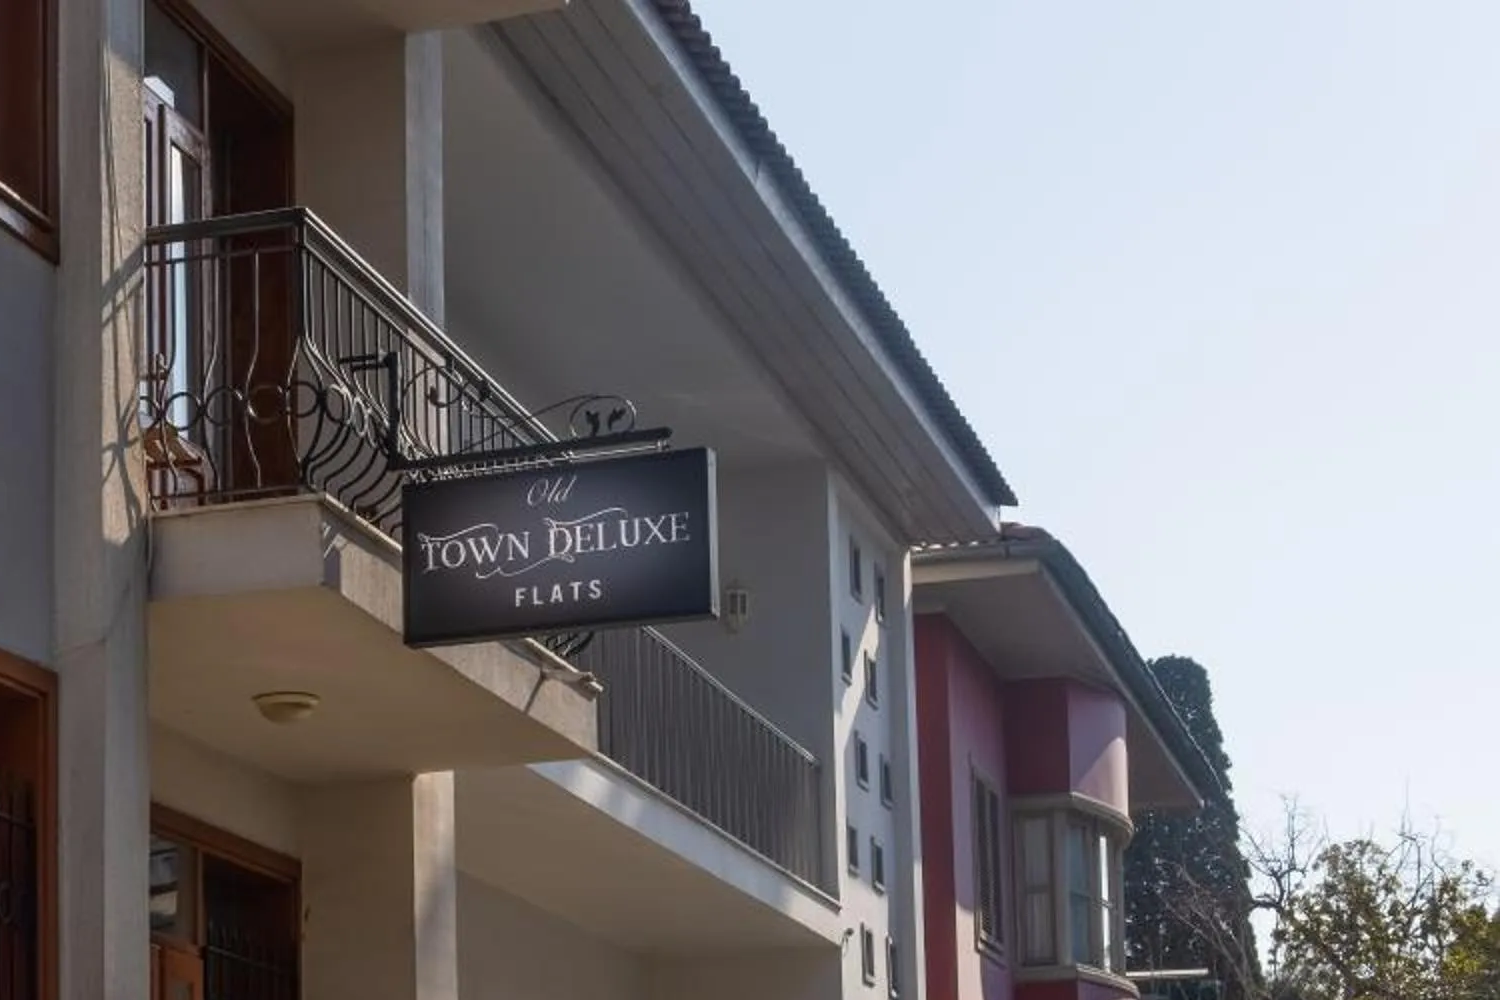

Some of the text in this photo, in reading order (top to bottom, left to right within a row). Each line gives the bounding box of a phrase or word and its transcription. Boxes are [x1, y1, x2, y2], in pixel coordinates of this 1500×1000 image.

[526, 475, 578, 506] Old
[417, 507, 691, 574] TOWN DELUXE
[514, 579, 602, 607] FLATS
